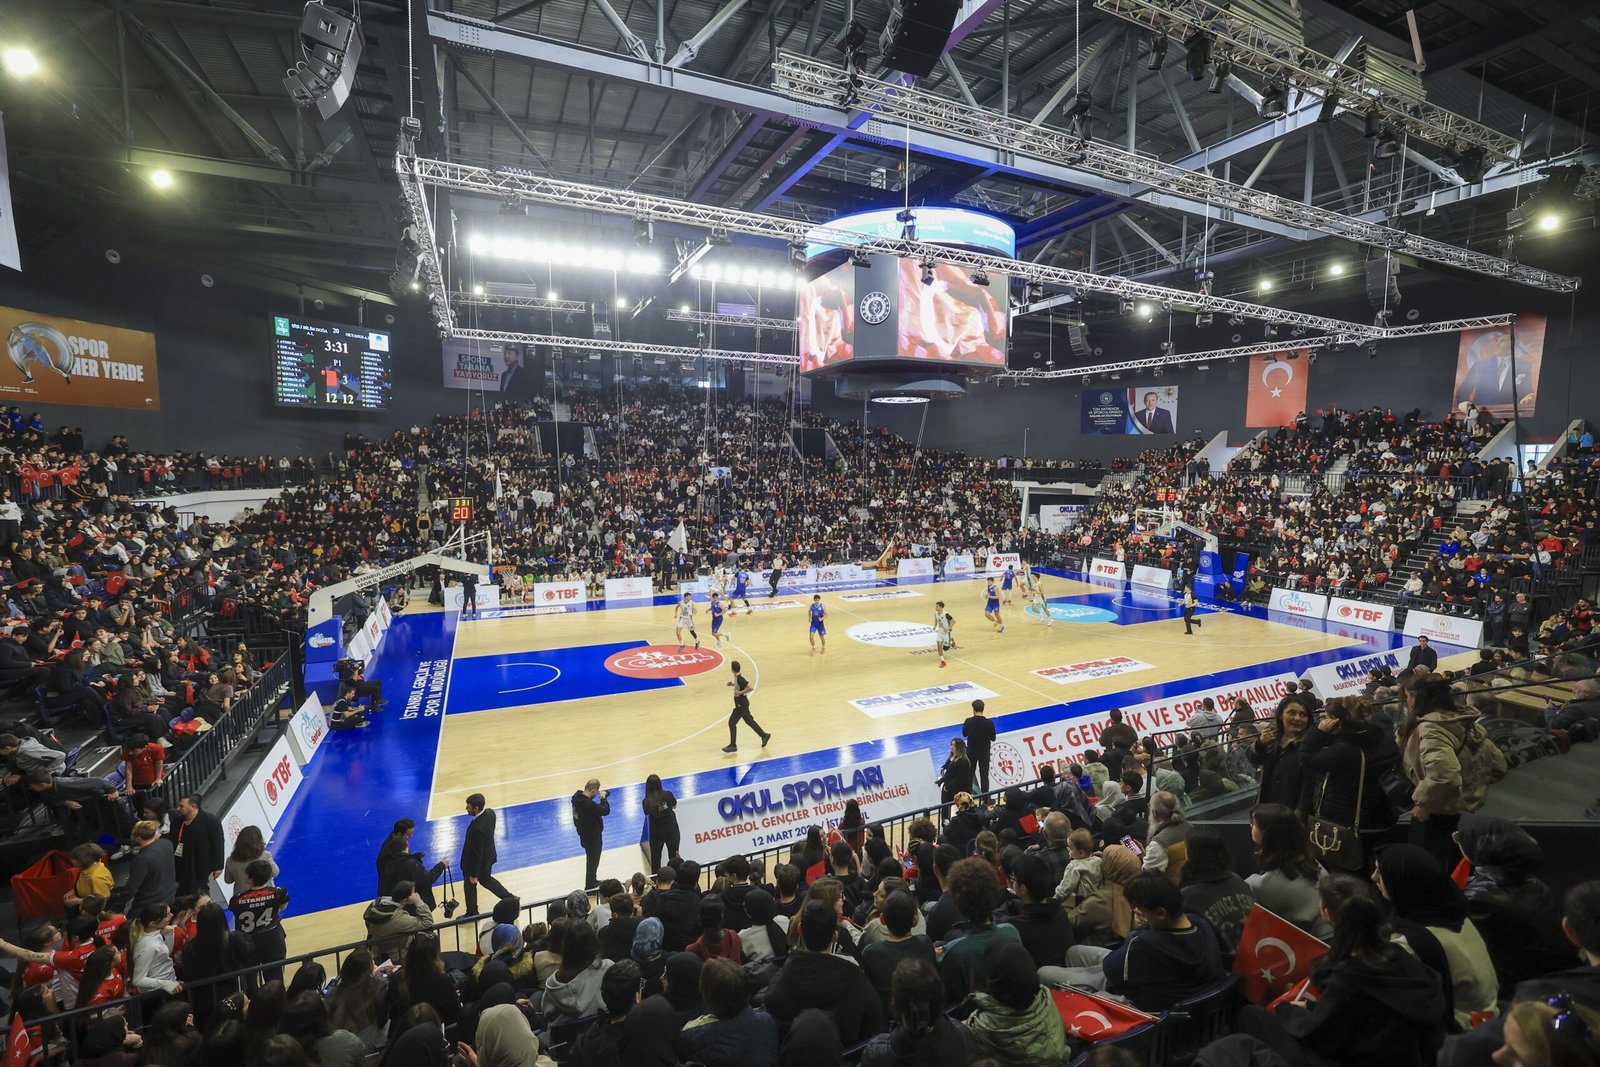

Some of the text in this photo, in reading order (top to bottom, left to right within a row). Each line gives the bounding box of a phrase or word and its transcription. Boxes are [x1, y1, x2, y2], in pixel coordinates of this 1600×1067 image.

[67, 335, 109, 359] SPOR
[324, 340, 349, 354] 3:31
[72, 358, 144, 383] HER YERDE
[325, 393, 338, 403] 12
[342, 394, 354, 404] 12
[453, 507, 468, 519] 20
[355, 571, 381, 584] İSTANBUL
[381, 563, 405, 576] GENÇLİK
[1103, 564, 1119, 575] TBF
[556, 588, 579, 601] TBF
[1353, 608, 1383, 622] TBF
[1336, 663, 1361, 681] OKUL
[399, 689, 424, 719] İSTANBUL
[424, 698, 441, 716] SPOR
[1023, 732, 1063, 757] T.C.
[1148, 706, 1173, 730] VE
[272, 754, 292, 790] TBF
[718, 765, 884, 820] OKUL SPORLARI
[695, 783, 910, 847] BASKETBOL GENÇLER TÜRKİY BİRİNCİLİĞİ
[751, 837, 763, 849] 12
[766, 829, 794, 846] MART
[239, 906, 274, 933] 34
